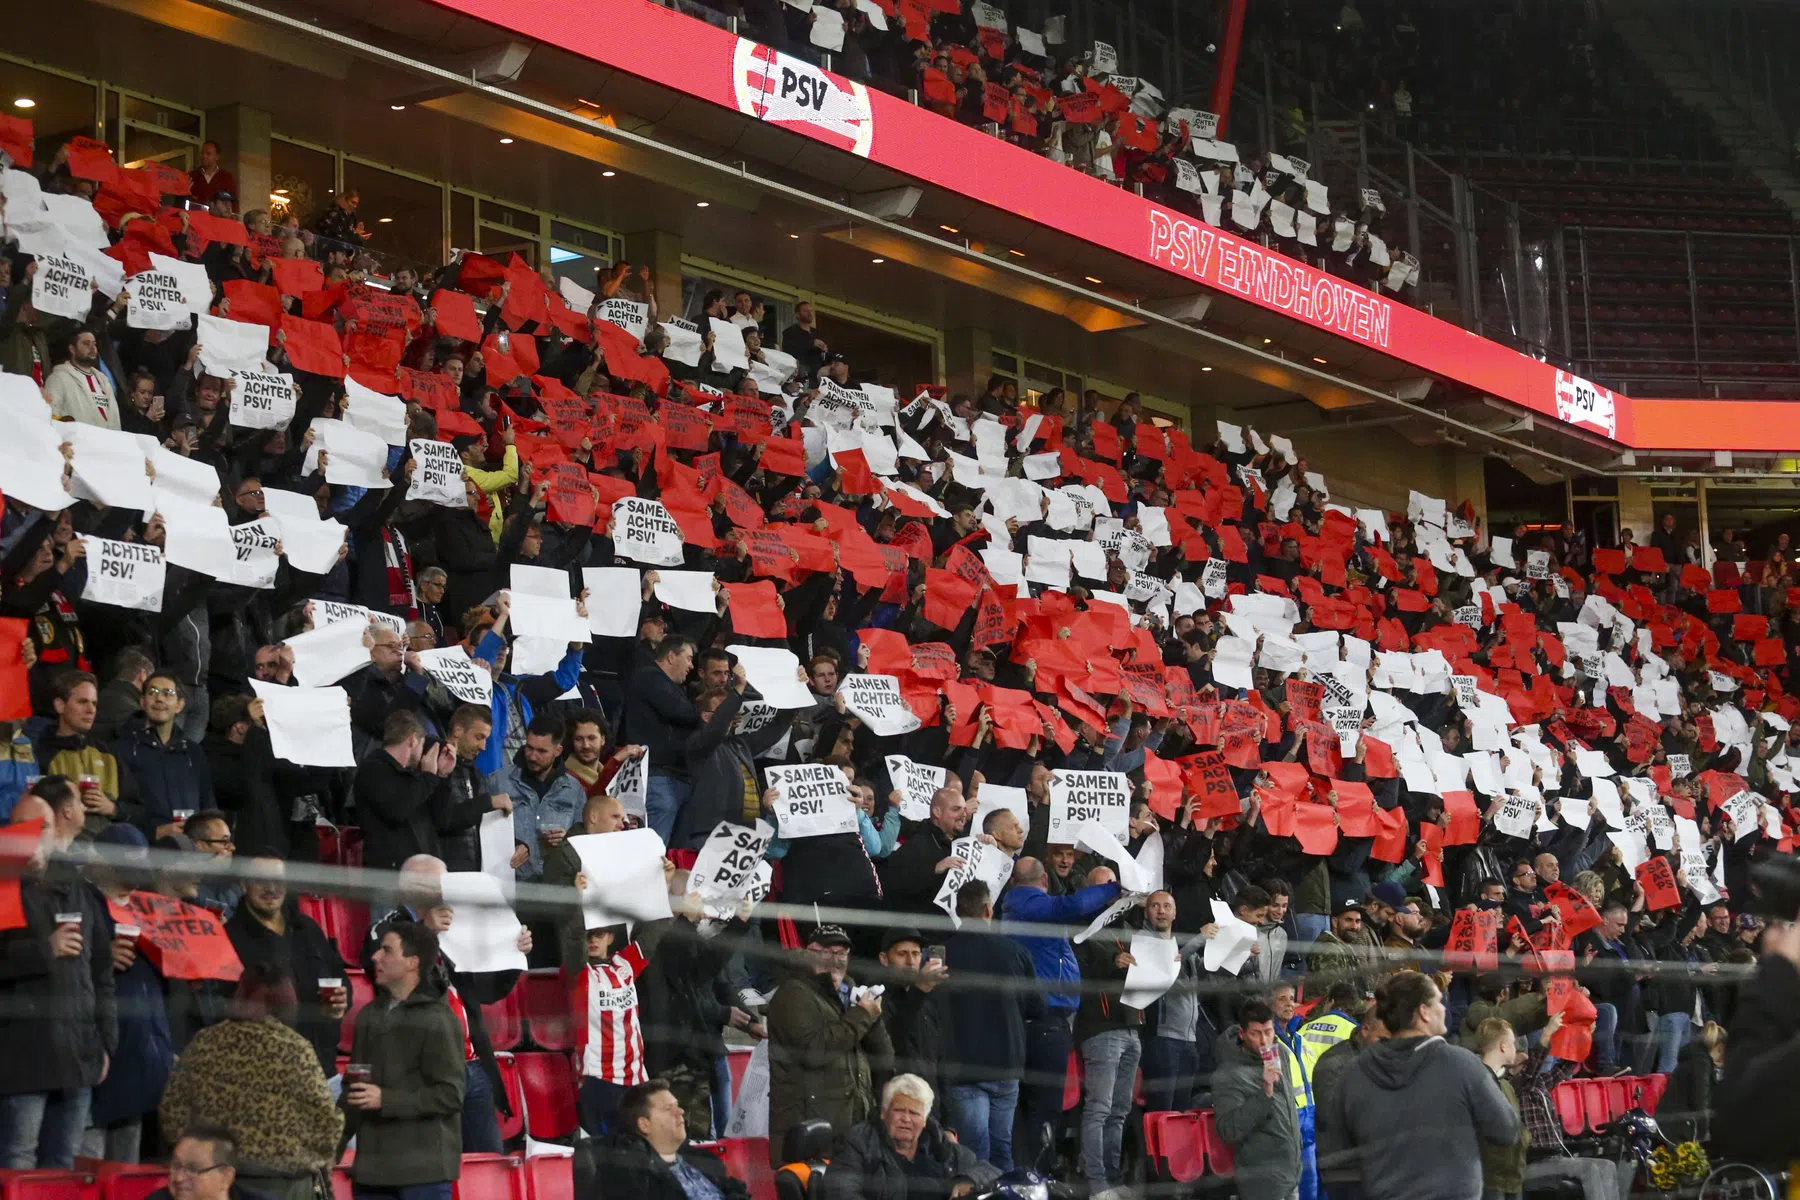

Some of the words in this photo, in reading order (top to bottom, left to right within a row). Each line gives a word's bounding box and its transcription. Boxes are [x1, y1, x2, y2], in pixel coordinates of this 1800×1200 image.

[782, 67, 828, 111] PSV
[1196, 112, 1214, 120] AMEN
[47, 255, 86, 276] SAMEN
[45, 268, 89, 291] ACHTER
[136, 274, 178, 289] SAMEN
[1150, 209, 1215, 277] PSV
[1218, 237, 1391, 347] EINDHOVEN
[44, 282, 69, 299] PSV!
[138, 287, 182, 303] ACHTER
[139, 299, 167, 312] PSV!
[606, 301, 638, 314] SAMEN
[608, 309, 643, 325] ACHTER
[240, 370, 287, 386] SAMEN
[244, 384, 292, 400] ACHTER
[1576, 386, 1595, 412] PSV
[243, 395, 272, 410] PSV!
[819, 399, 839, 412] PSV!
[424, 444, 458, 460] SAMEN
[425, 457, 462, 474] ACHTER
[424, 471, 446, 486] PSV!
[627, 515, 677, 534] ACHTER
[626, 528, 656, 544] PSV!
[102, 541, 160, 564] ACHTER
[236, 546, 252, 561] V!
[101, 558, 134, 580] PSV!
[1136, 579, 1154, 590] PSV!
[849, 678, 891, 690] SAMEN
[853, 692, 900, 706] ACHTER
[751, 704, 778, 716] SAM
[784, 767, 834, 784] SAMEN
[1066, 773, 1118, 790] SAMEN
[788, 782, 846, 800] ACHTER
[1067, 790, 1126, 807] ACHTER
[790, 799, 824, 816] PSV!
[1506, 796, 1536, 811] ACHTER
[1067, 807, 1100, 821] PSV!
